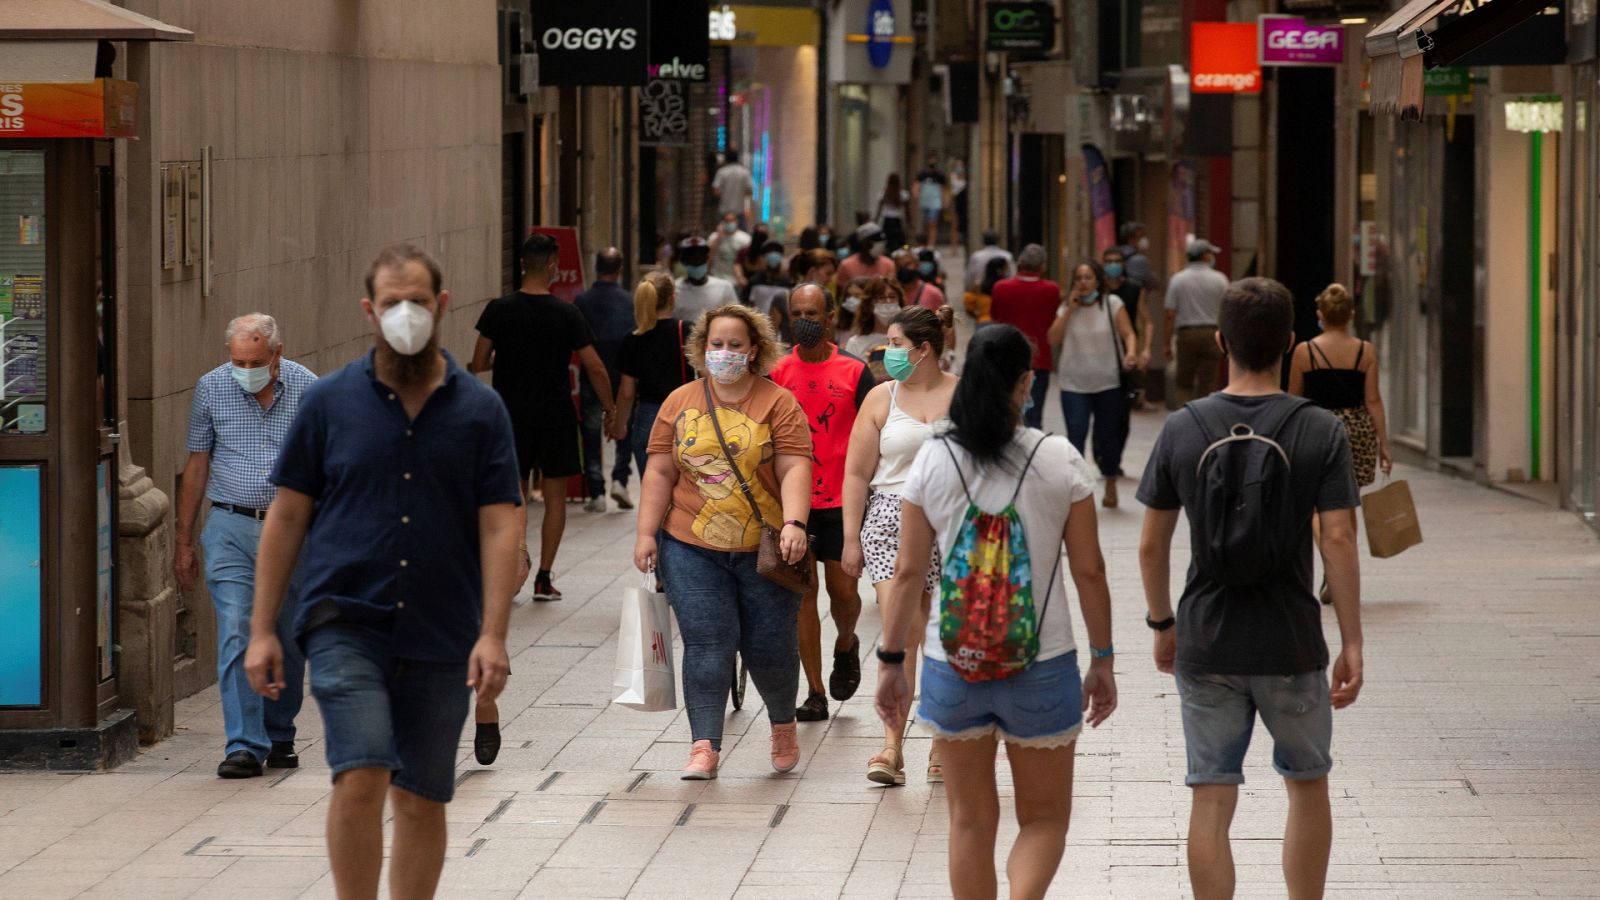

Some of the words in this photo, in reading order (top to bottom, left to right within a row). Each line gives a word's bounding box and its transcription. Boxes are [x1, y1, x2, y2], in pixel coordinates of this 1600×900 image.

[542, 27, 637, 50] OGGYS
[1268, 30, 1339, 49] GESA
[1194, 73, 1256, 91] orange
[959, 646, 986, 660] ara
